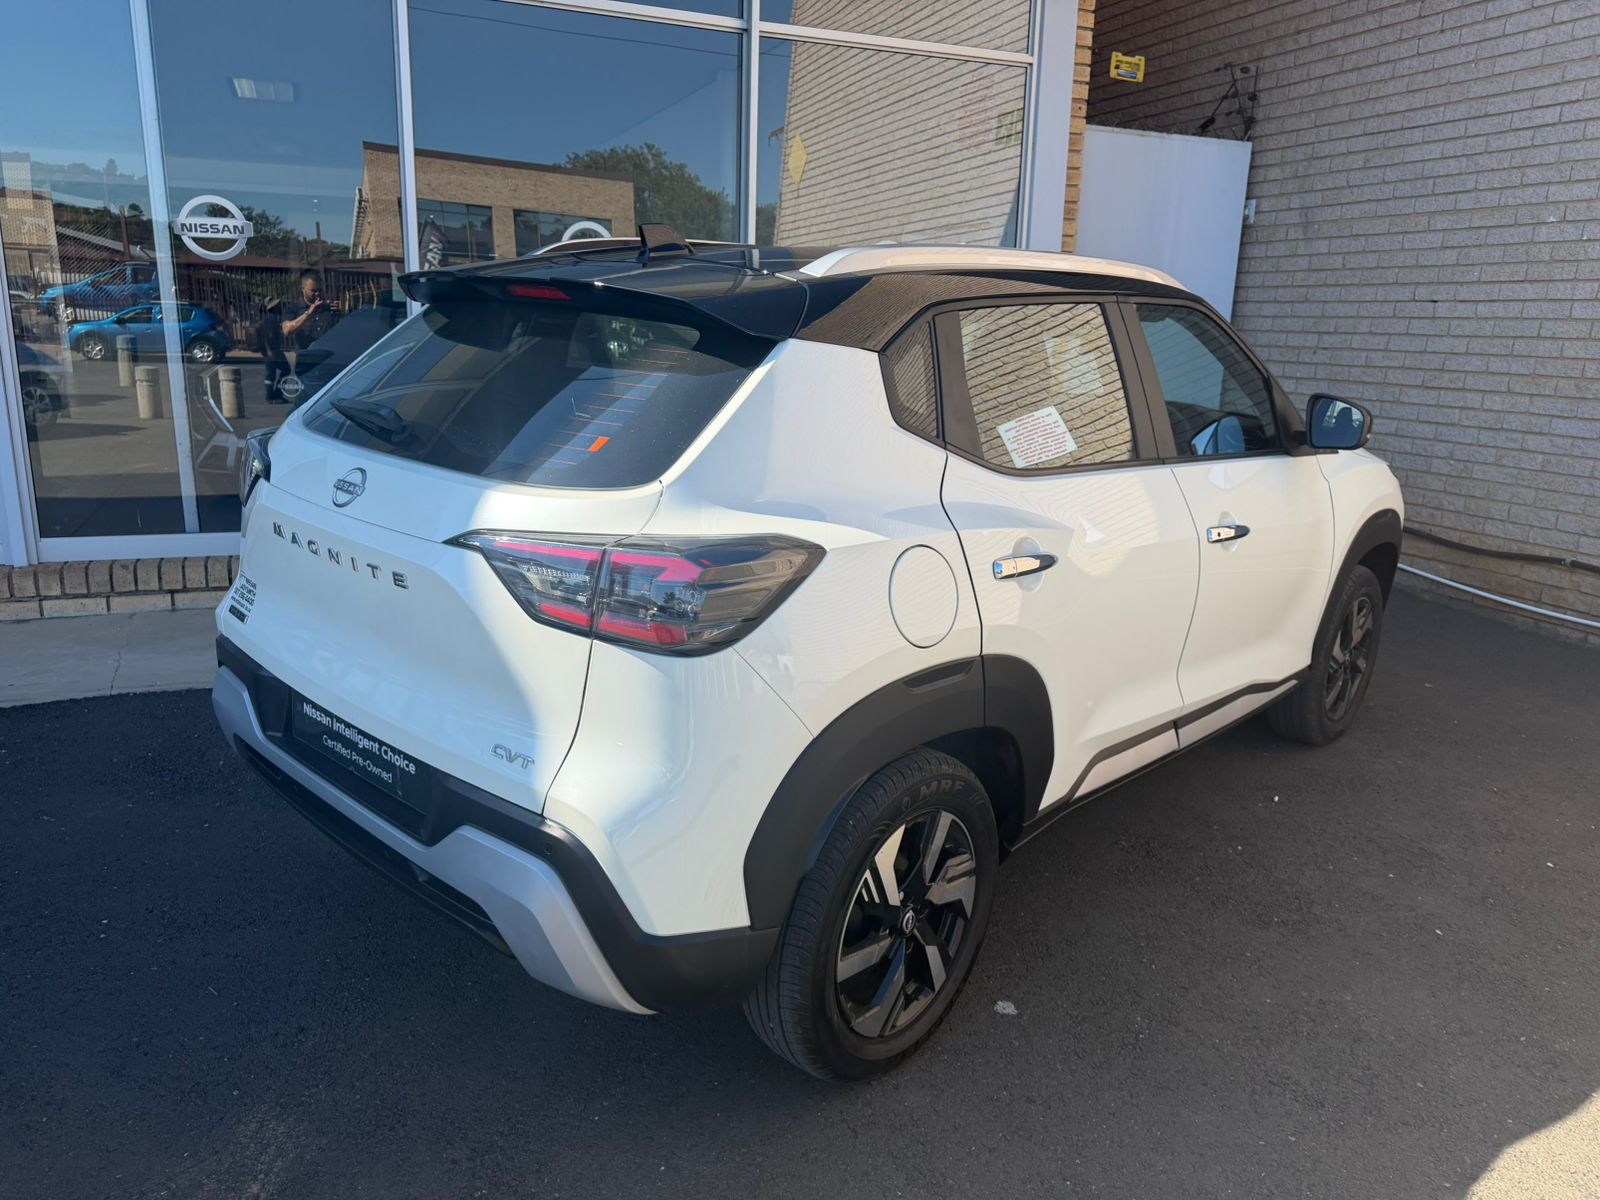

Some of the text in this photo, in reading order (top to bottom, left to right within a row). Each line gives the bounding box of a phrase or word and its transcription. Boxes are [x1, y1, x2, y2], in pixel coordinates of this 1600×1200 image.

[180, 222, 245, 235] NISSAN
[273, 521, 409, 590] MAGNITE
[303, 702, 416, 775] Nissan Intelligent Choice
[490, 743, 535, 770] CVT
[322, 735, 393, 783] Certified Pre-Owned
[920, 779, 965, 799] MRF
